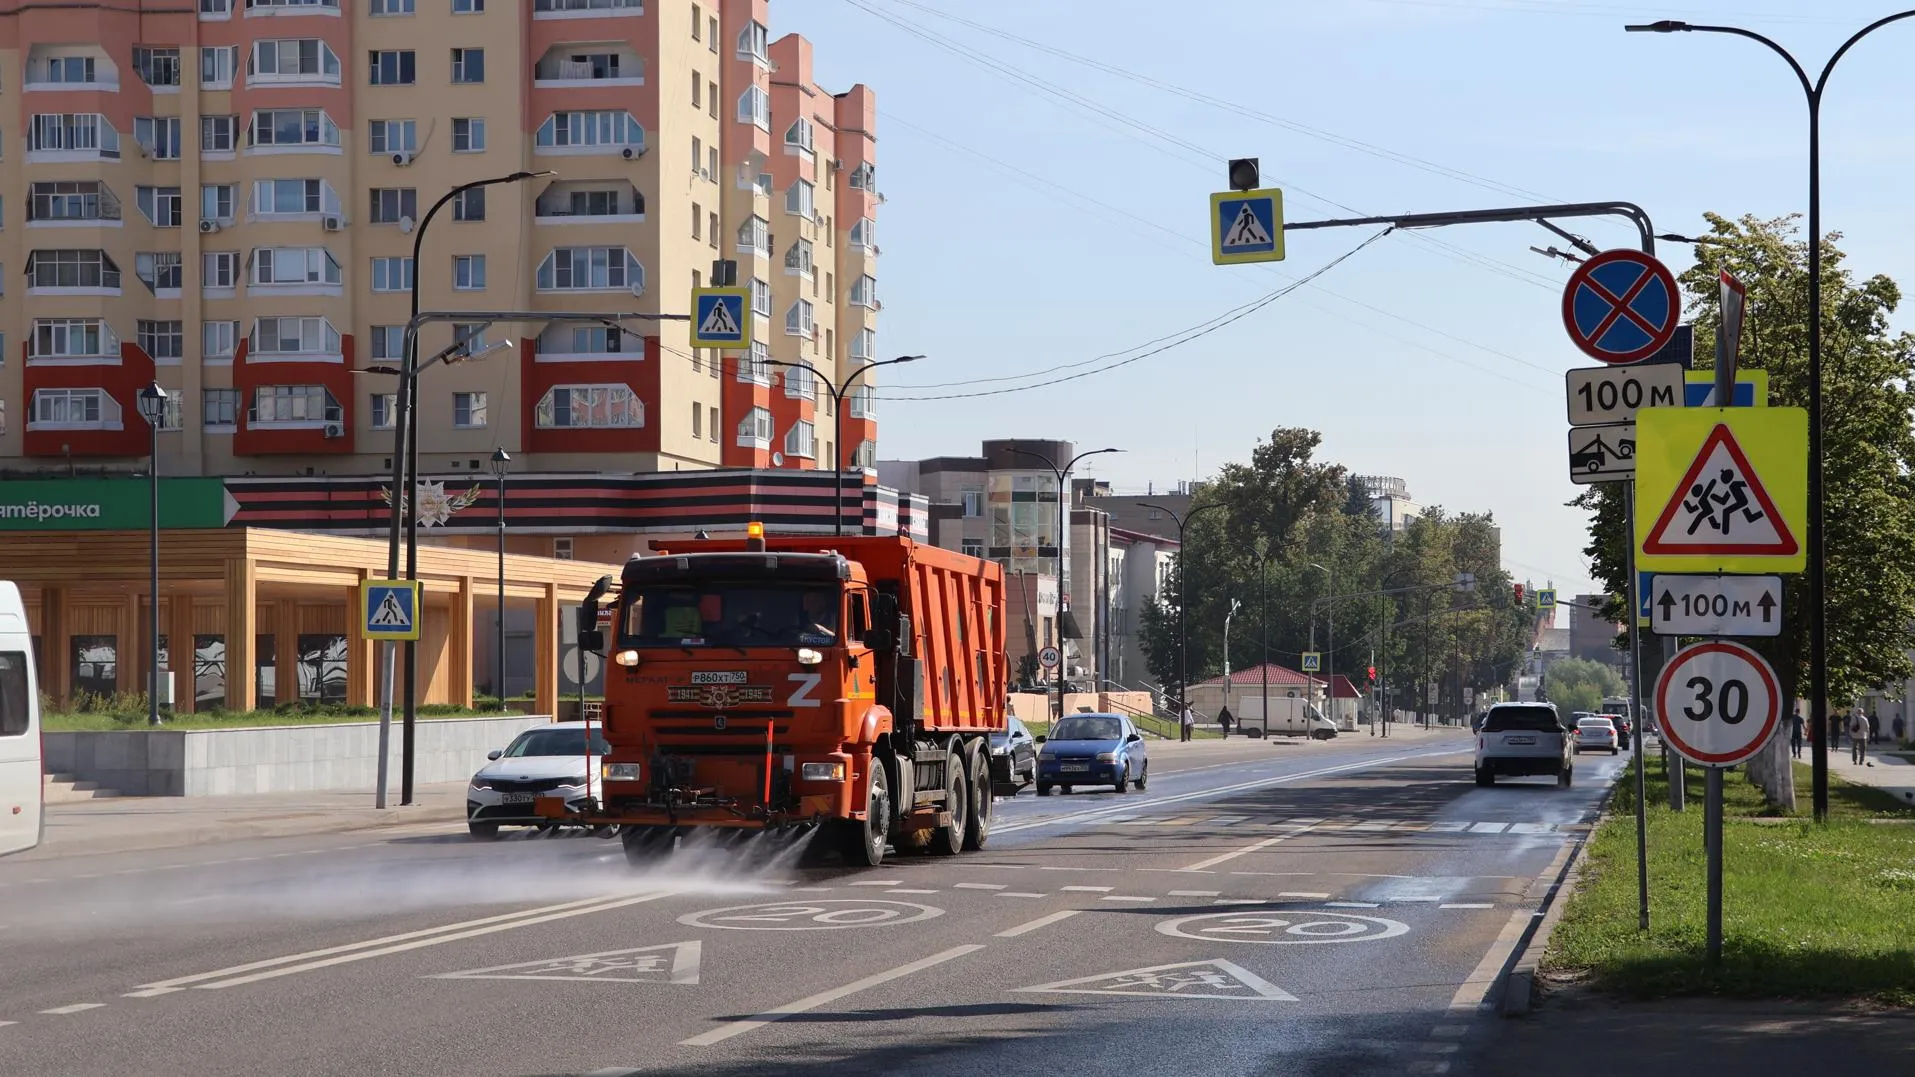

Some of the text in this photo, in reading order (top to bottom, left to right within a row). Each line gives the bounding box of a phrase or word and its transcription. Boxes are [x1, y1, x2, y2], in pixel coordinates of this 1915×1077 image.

[1043, 652, 1056, 661] 40
[677, 689, 694, 699] 1941
[745, 689, 762, 699] 1945
[787, 673, 821, 707] Z
[1683, 676, 1749, 725] 30
